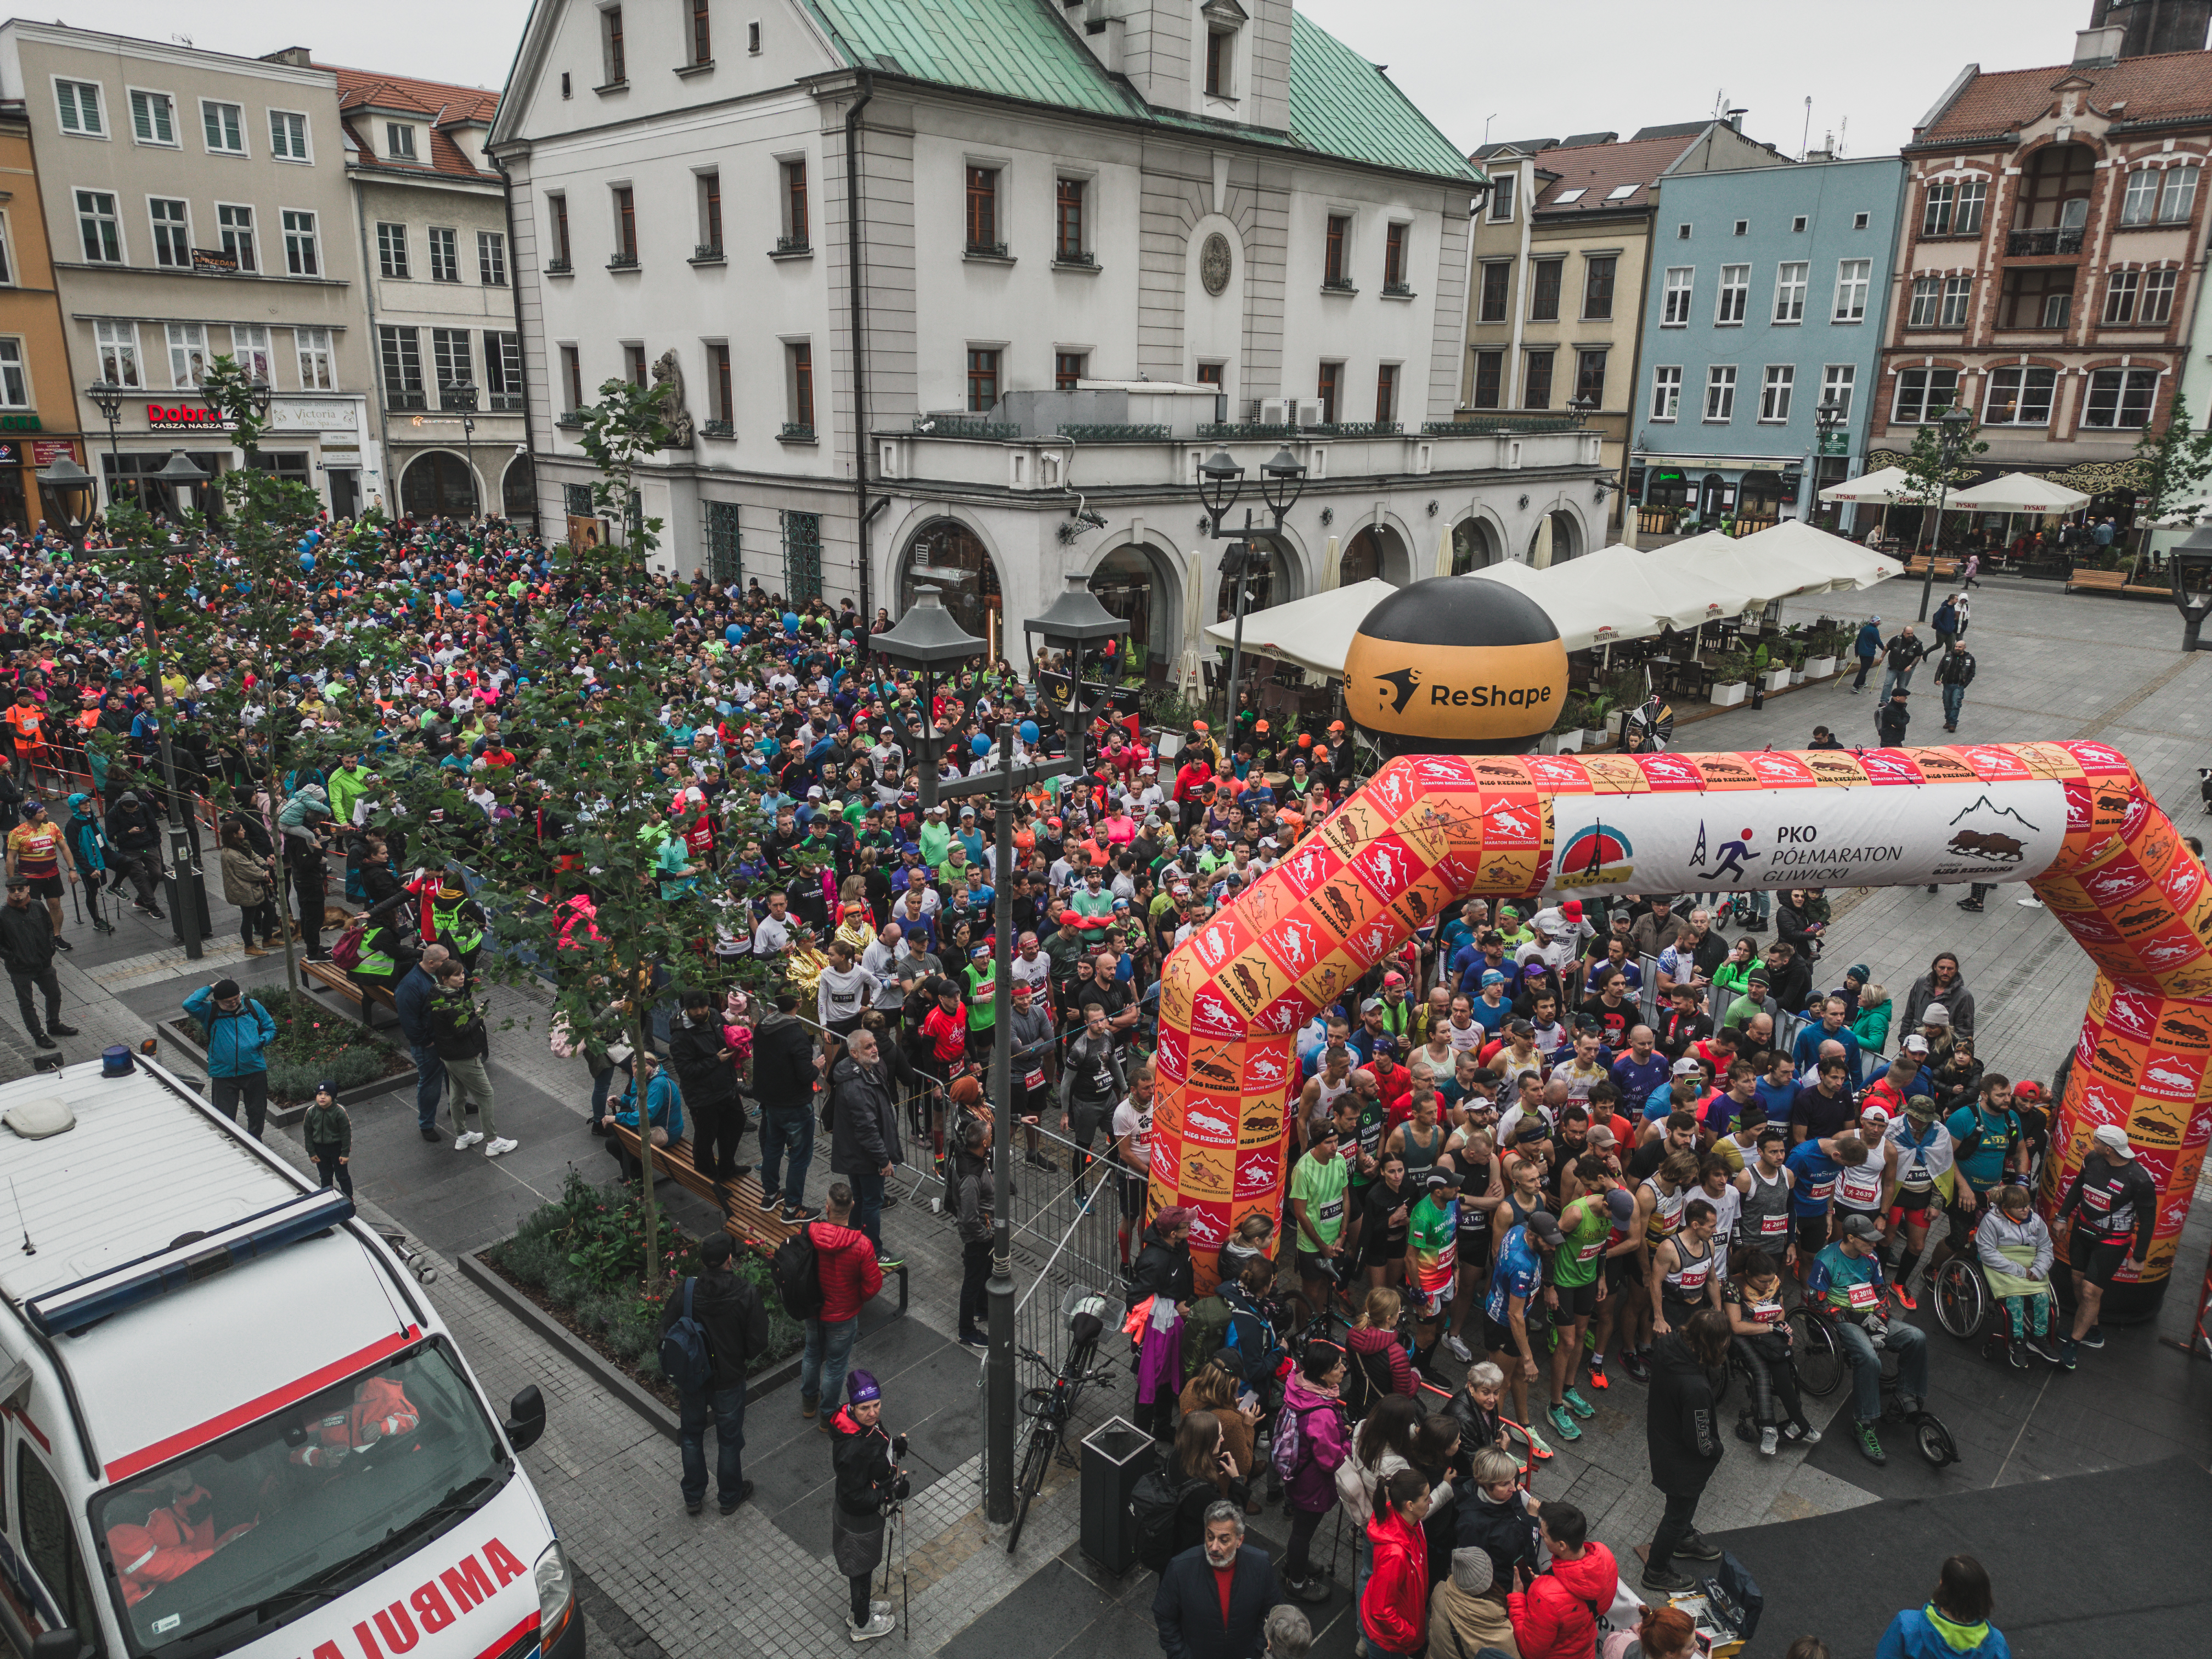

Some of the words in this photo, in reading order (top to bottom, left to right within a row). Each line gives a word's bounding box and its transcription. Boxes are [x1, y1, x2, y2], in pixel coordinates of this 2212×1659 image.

[195, 257, 236, 267] SPRZEDAM
[294, 408, 336, 420] Victoria
[0, 416, 42, 430] CKA
[302, 420, 315, 428] Day
[1594, 631, 1620, 642] ZWIERZYNIEC
[1431, 683, 1551, 709] ReShape
[1778, 825, 1817, 843] PKO
[1771, 846, 1903, 865] PÓŁMARATON
[1763, 868, 1849, 882] GLIWICKI
[1351, 860, 1369, 880] MARATON
[1367, 878, 1390, 903] BIESZCZADZKI
[1262, 936, 1278, 956] MARATON
[1277, 955, 1300, 979] BIESZCZADZKI
[1193, 1026, 1215, 1035] MARATON
[1181, 1183, 1201, 1192] MARATON
[2106, 1186, 2121, 1194] POLAND
[2091, 1194, 2106, 1205] 2802
[1330, 1204, 1341, 1213] 1202
[1859, 1289, 1872, 1297] 2010
